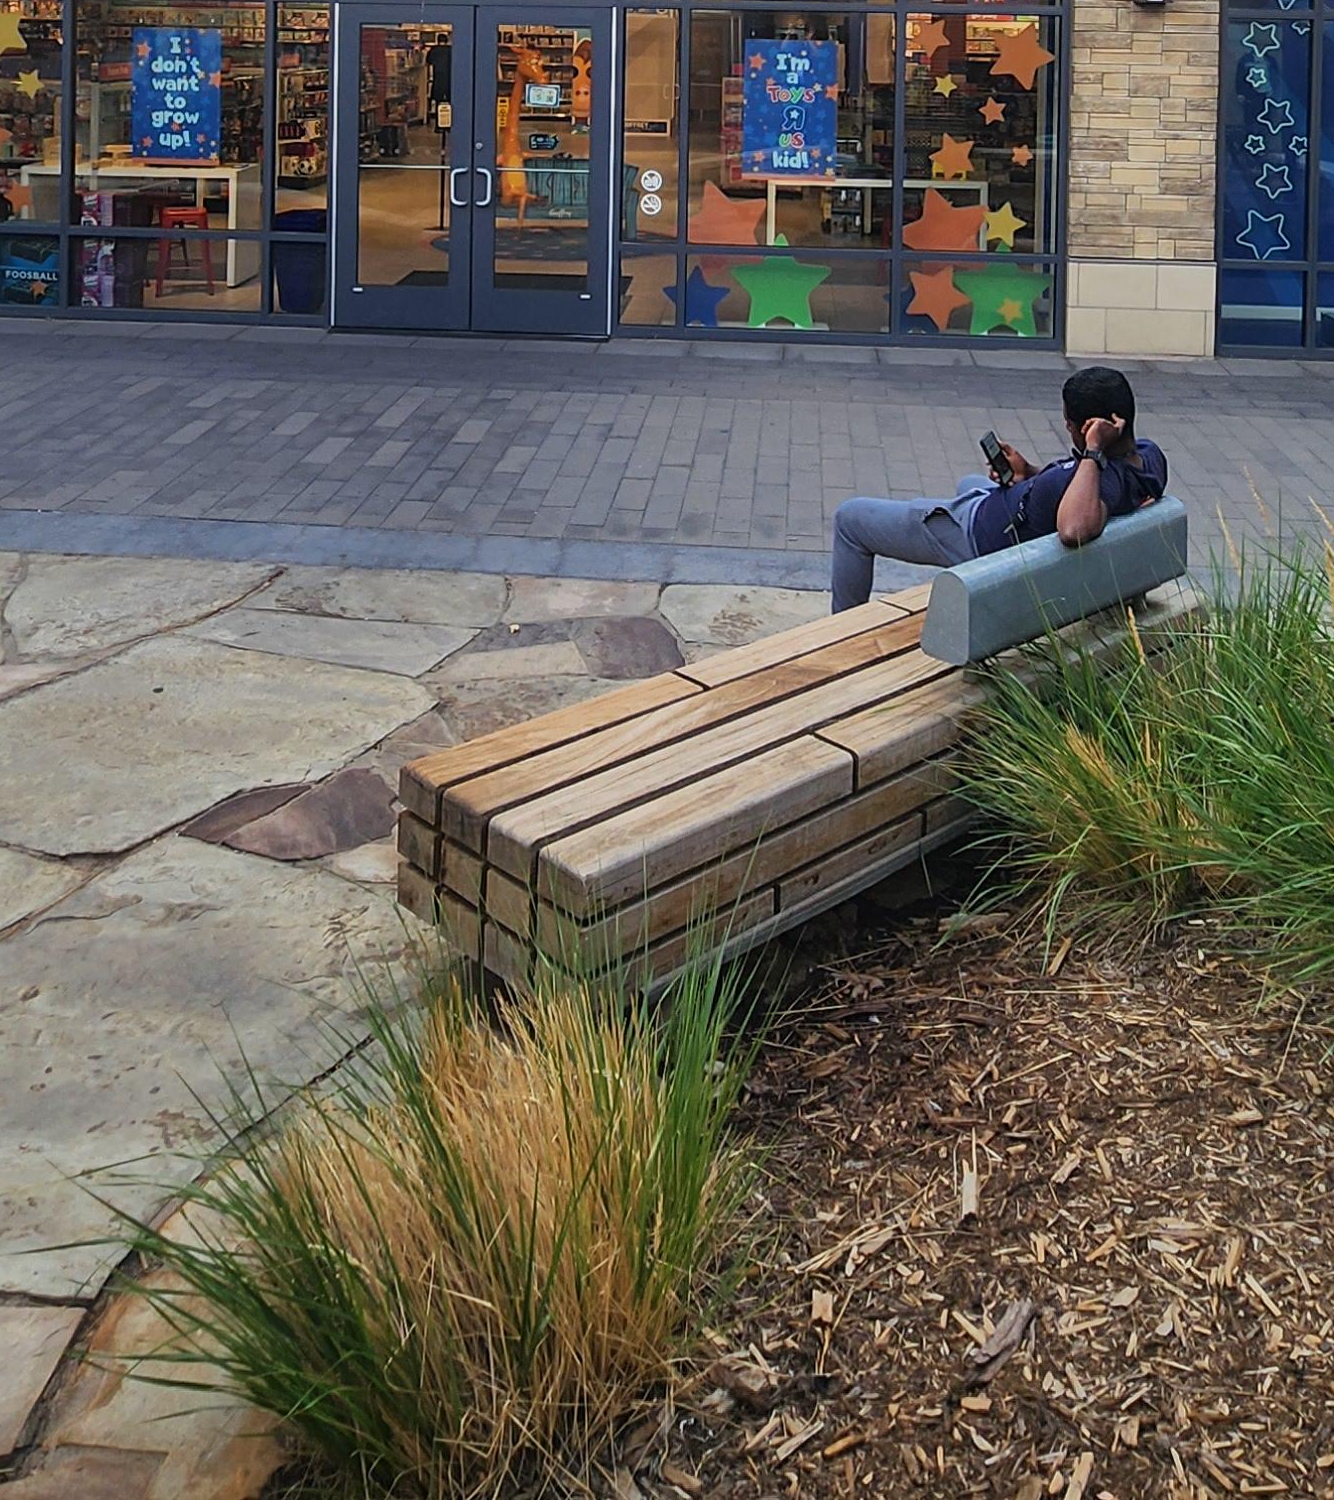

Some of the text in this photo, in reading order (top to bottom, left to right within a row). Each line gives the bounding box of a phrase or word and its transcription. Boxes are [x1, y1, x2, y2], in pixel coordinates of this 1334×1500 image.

[169, 36, 182, 54] I
[151, 55, 201, 73] don't
[776, 53, 810, 71] I'm
[151, 76, 200, 91] want
[786, 71, 799, 84] a
[164, 92, 187, 109] to
[151, 110, 200, 128] grow
[158, 130, 192, 150] up!
[772, 150, 810, 169] kid!
[5, 269, 59, 281] FOOSBALL
